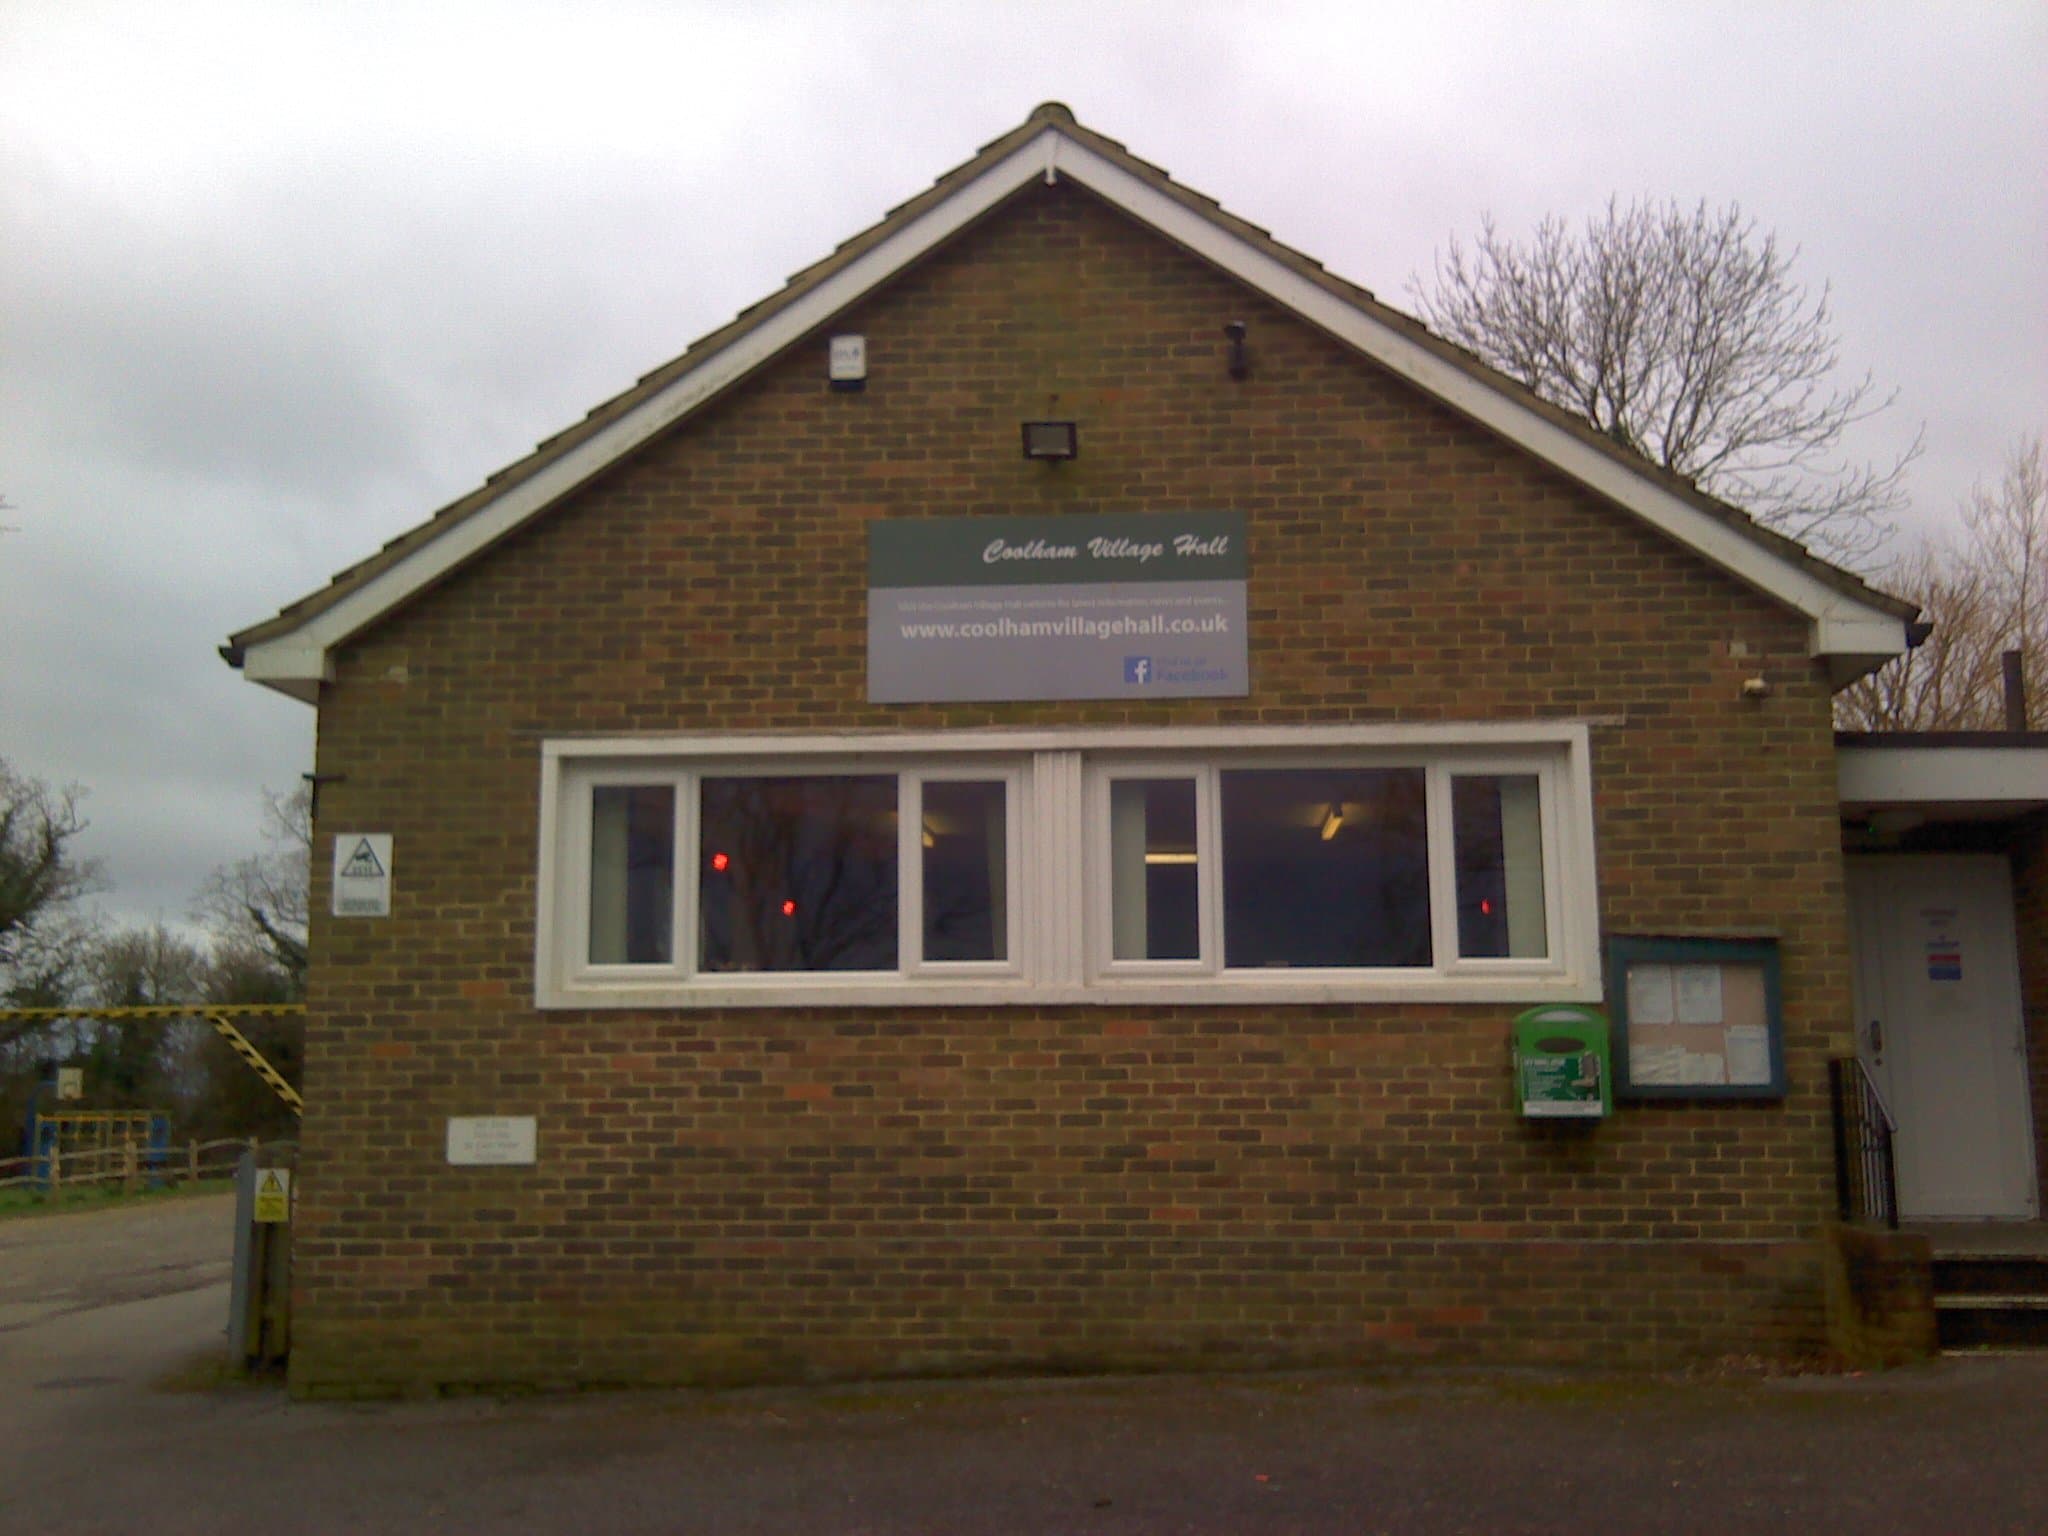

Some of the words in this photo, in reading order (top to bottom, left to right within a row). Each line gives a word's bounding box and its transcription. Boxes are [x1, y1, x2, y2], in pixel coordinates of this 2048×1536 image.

[983, 538, 1077, 563] Coolham
[1087, 536, 1163, 563] Village
[1173, 533, 1229, 557] Hall
[900, 613, 1229, 640] www.coolhamvillagehall.co.uk
